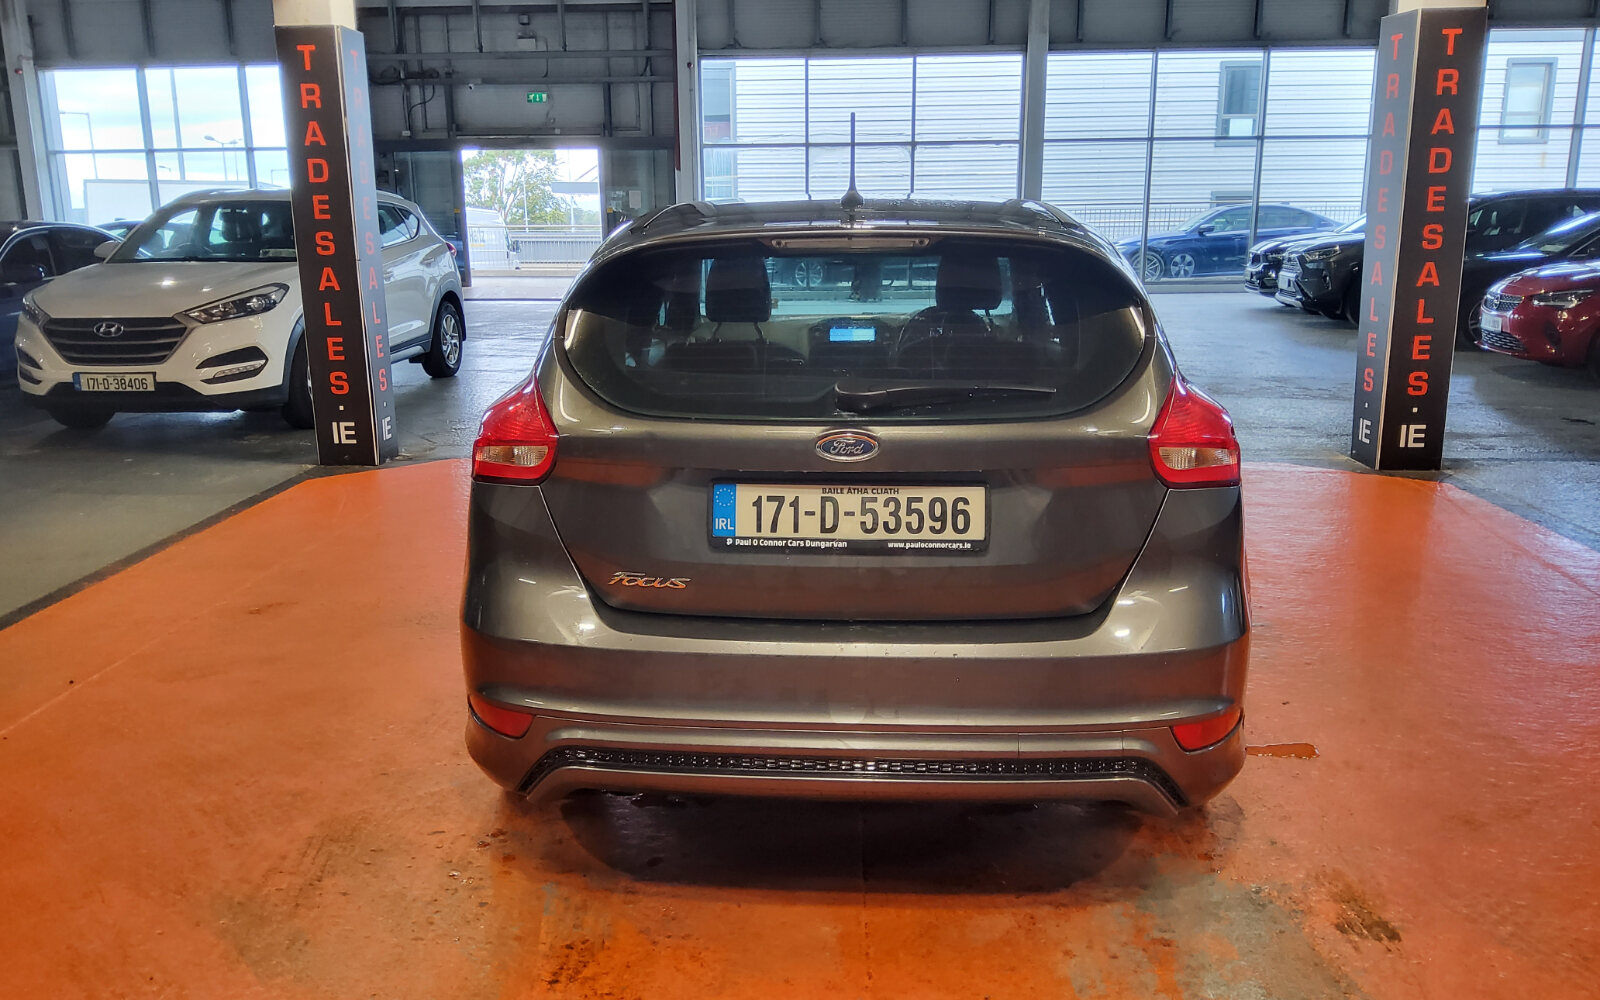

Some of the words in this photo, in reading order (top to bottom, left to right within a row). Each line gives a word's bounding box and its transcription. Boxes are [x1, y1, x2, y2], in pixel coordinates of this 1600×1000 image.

[86, 377, 149, 390] 171-D-38406
[830, 438, 864, 454] Ford
[871, 487, 900, 495] CLIATH
[752, 495, 971, 535] 171-D-53596
[715, 518, 735, 530] IRL
[759, 539, 786, 547] Connor
[805, 540, 848, 549] Dungarvan
